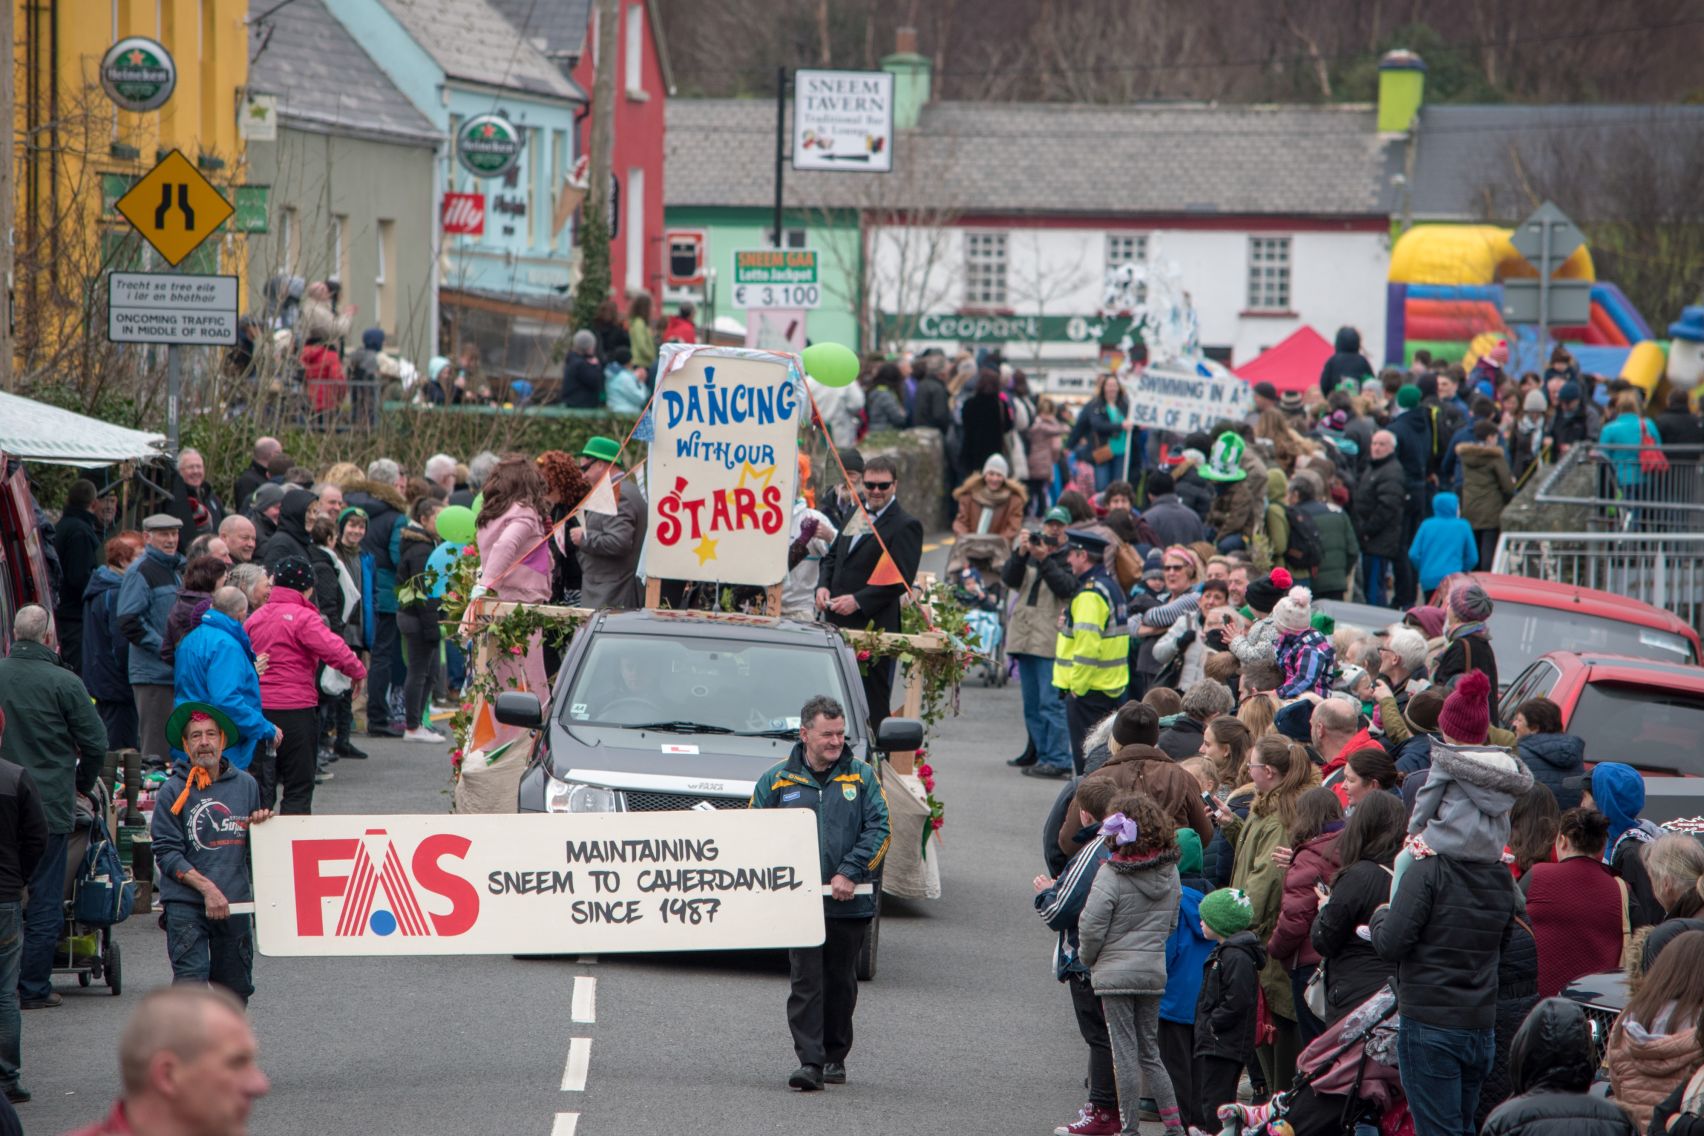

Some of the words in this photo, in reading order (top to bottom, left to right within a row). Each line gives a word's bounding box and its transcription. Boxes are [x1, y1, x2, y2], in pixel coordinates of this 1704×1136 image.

[108, 68, 167, 82] Heineken
[808, 80, 879, 94] SNEEM
[803, 96, 884, 112] TAVERN
[444, 197, 483, 230] illy
[739, 252, 784, 267] SNEEM
[787, 252, 814, 267] GAA
[153, 283, 166, 291] sa
[171, 282, 192, 291] treo
[196, 283, 216, 293] eile
[116, 313, 177, 324] ONCOMING
[182, 315, 225, 326] TRAFFIC
[122, 325, 133, 335] IN
[137, 326, 177, 336] MIDDLE
[181, 328, 197, 337] OF
[200, 328, 231, 338] ROAD
[1138, 374, 1204, 399] SWIMMING
[1209, 382, 1225, 403] IN
[1230, 386, 1240, 404] A
[662, 379, 796, 430] DANCING
[1134, 403, 1158, 423] SEA
[1165, 408, 1181, 427] OF
[677, 430, 735, 470] WITH
[734, 444, 776, 466] OUR
[656, 484, 783, 547] STARS
[566, 838, 719, 864] MAINTAINING
[488, 870, 575, 895] SNEEM
[588, 869, 621, 893] TO
[637, 866, 803, 894] CAHERDANIEL
[571, 899, 644, 925] SINCE
[659, 898, 722, 925] 1987
